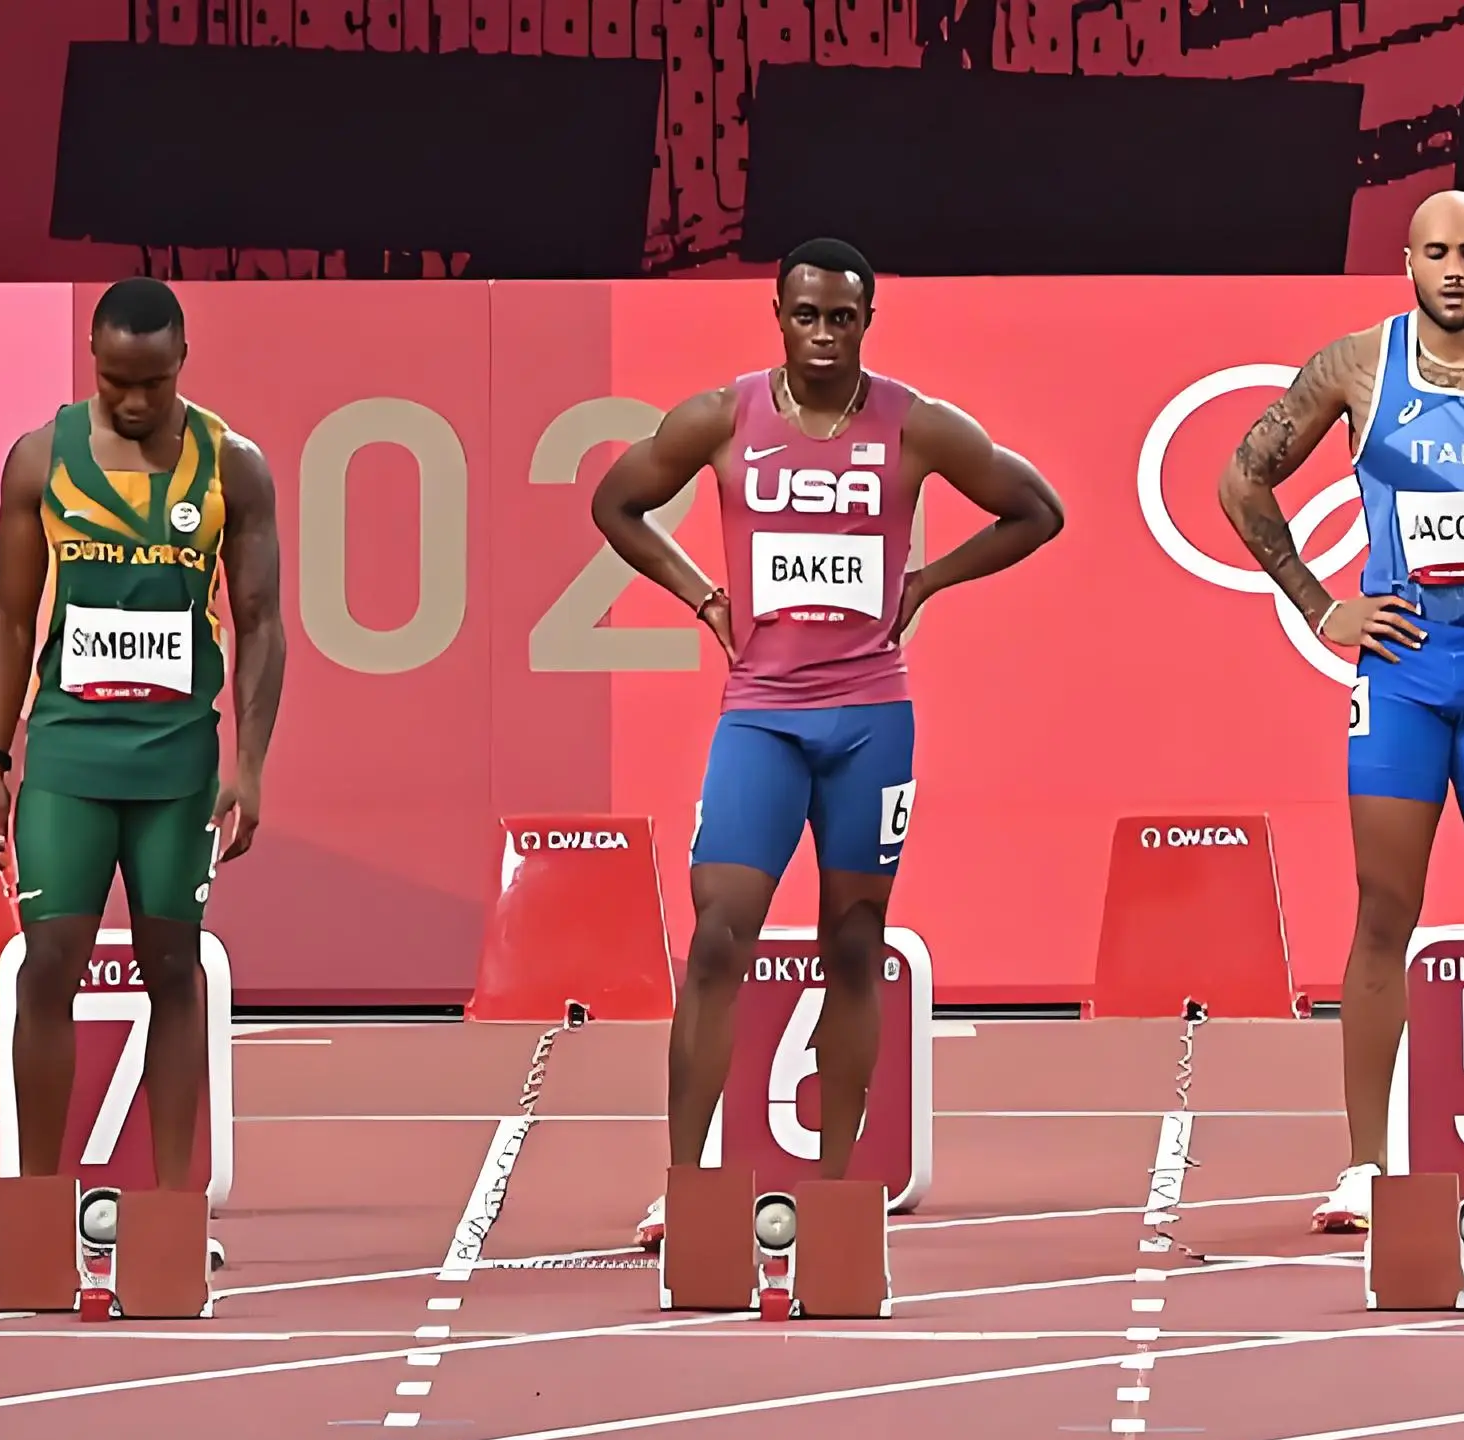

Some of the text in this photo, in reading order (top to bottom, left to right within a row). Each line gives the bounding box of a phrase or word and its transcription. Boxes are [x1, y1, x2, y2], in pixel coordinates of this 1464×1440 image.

[745, 466, 881, 516] USA
[772, 555, 863, 583] BAKER
[891, 789, 909, 836] 6
[743, 956, 825, 982] OKYO
[72, 992, 152, 1165] 7
